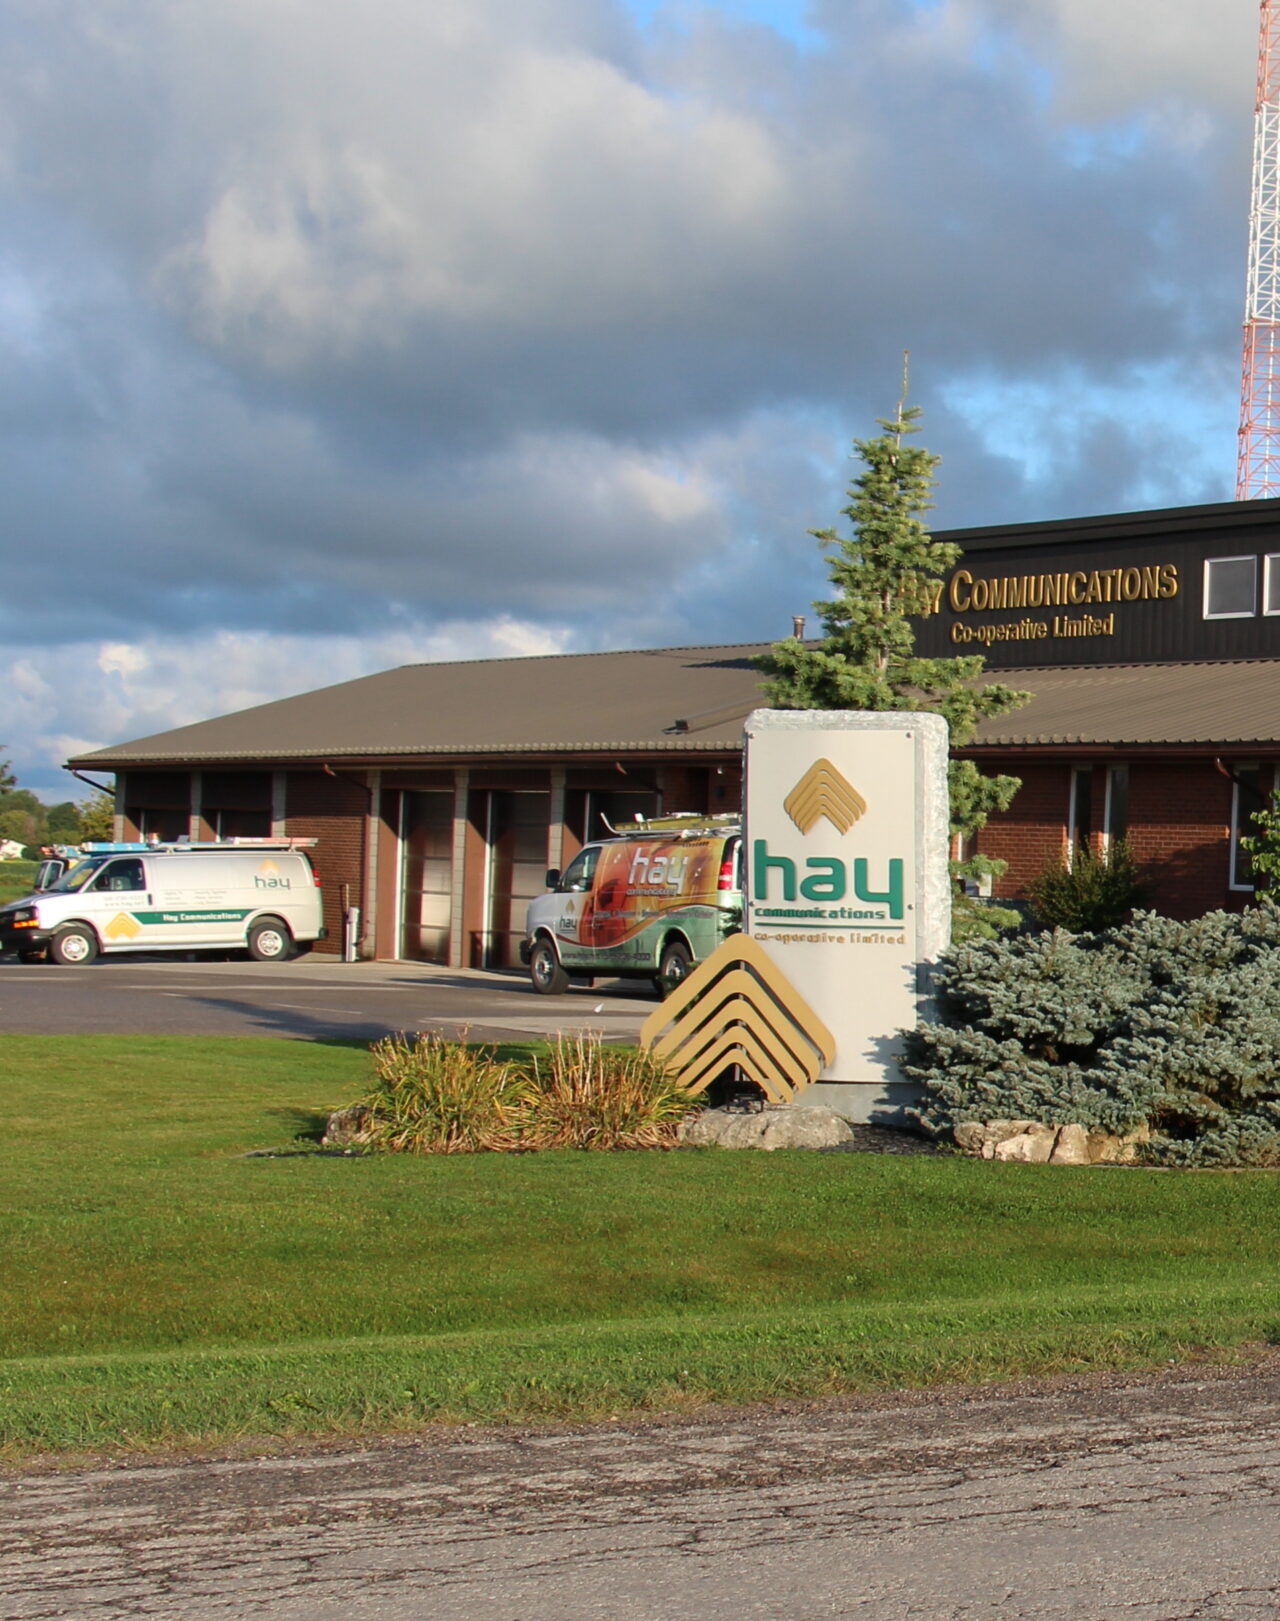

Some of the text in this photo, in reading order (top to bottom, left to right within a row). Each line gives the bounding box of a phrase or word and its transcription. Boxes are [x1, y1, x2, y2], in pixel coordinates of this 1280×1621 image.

[949, 563, 1179, 612] COMMUNICATIONS
[951, 612, 1115, 646] Co-operative Limited
[627, 846, 689, 895] hay
[753, 838, 905, 920] hay
[254, 874, 290, 890] hay
[162, 911, 242, 923] Hay Communications
[754, 907, 886, 920] communications
[559, 914, 578, 932] hay
[754, 931, 906, 945] co-operative limited
